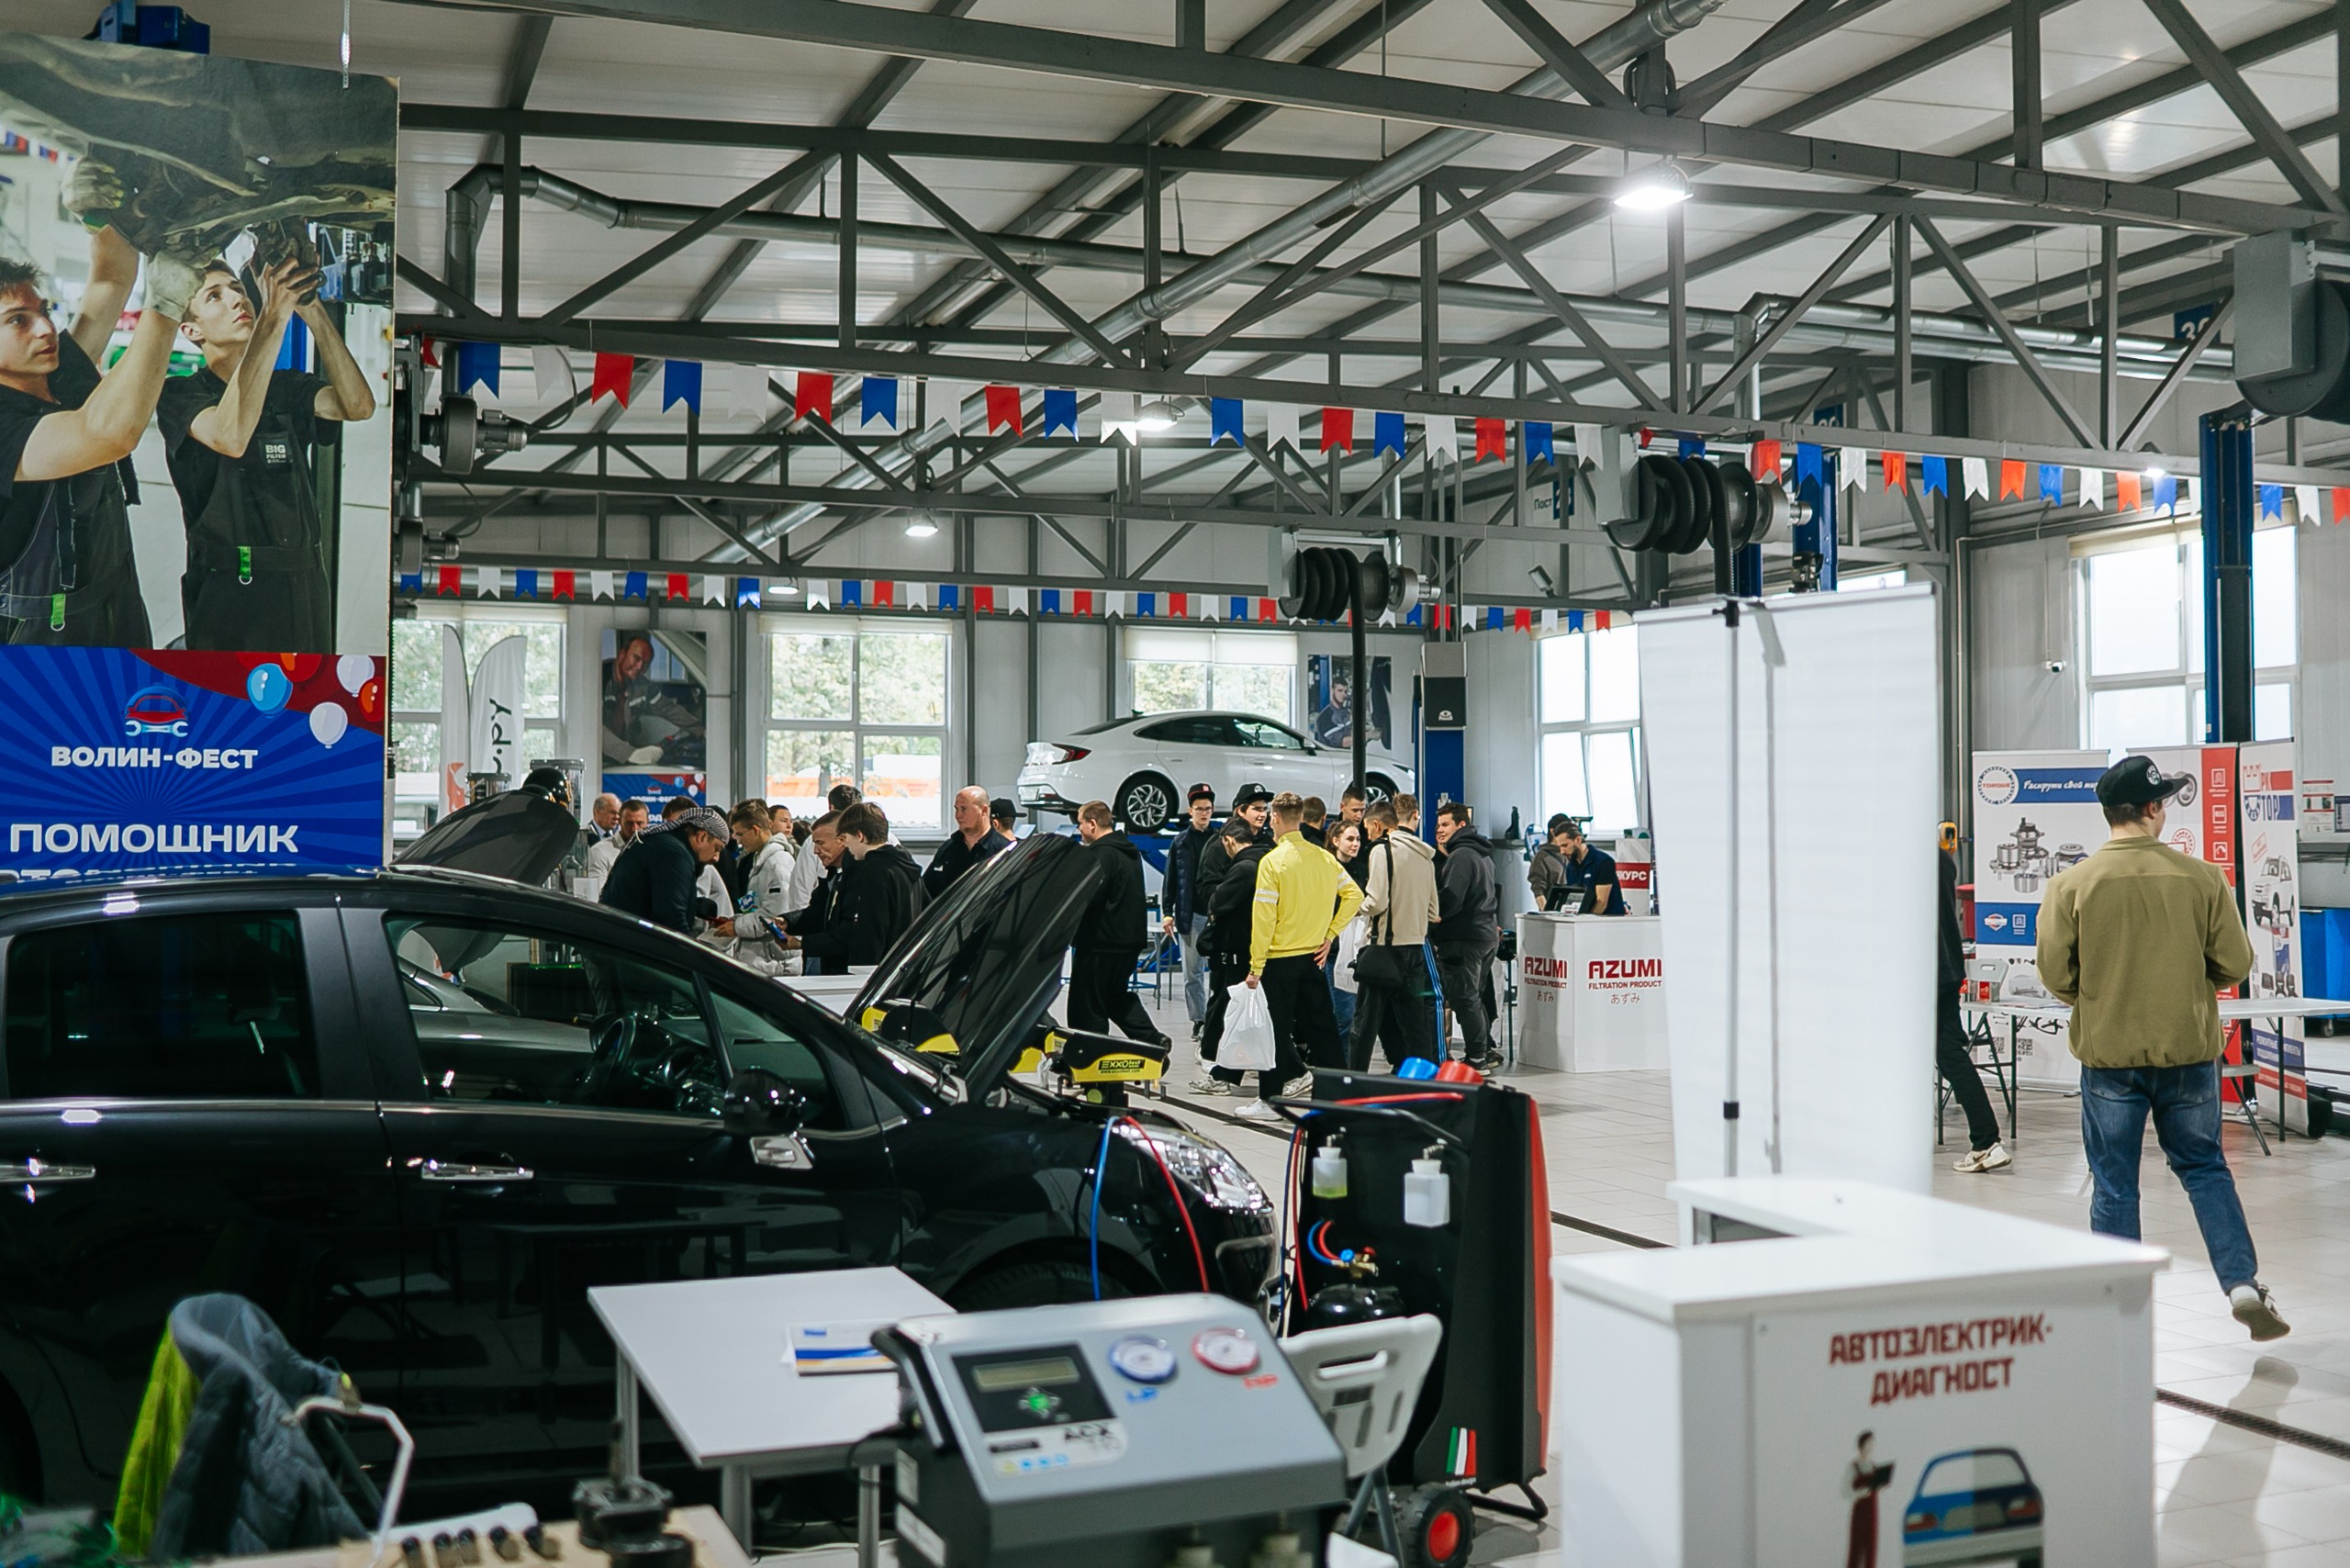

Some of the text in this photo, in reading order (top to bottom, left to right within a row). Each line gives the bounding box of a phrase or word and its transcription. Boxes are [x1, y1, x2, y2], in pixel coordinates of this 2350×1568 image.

[265, 444, 286, 454] BIG
[1534, 498, 1552, 510] Пост
[50, 745, 259, 769] ВОЛИН-ФЕСТ
[2023, 779, 2063, 793] Раскрути
[10, 823, 299, 853] ПОМОЩНИК
[1524, 956, 1568, 980] AZUMI
[1588, 958, 1662, 980] AZUMI
[1524, 977, 1568, 990] FILTRATION PRODUCT
[1588, 980, 1662, 990] FILTRATION PRODUCT
[1611, 992, 1641, 1005] あずみ
[1829, 1312, 2053, 1366] АВТОЭЛЕКТРИК-
[1870, 1357, 2015, 1406] ДИАГНОСТ
